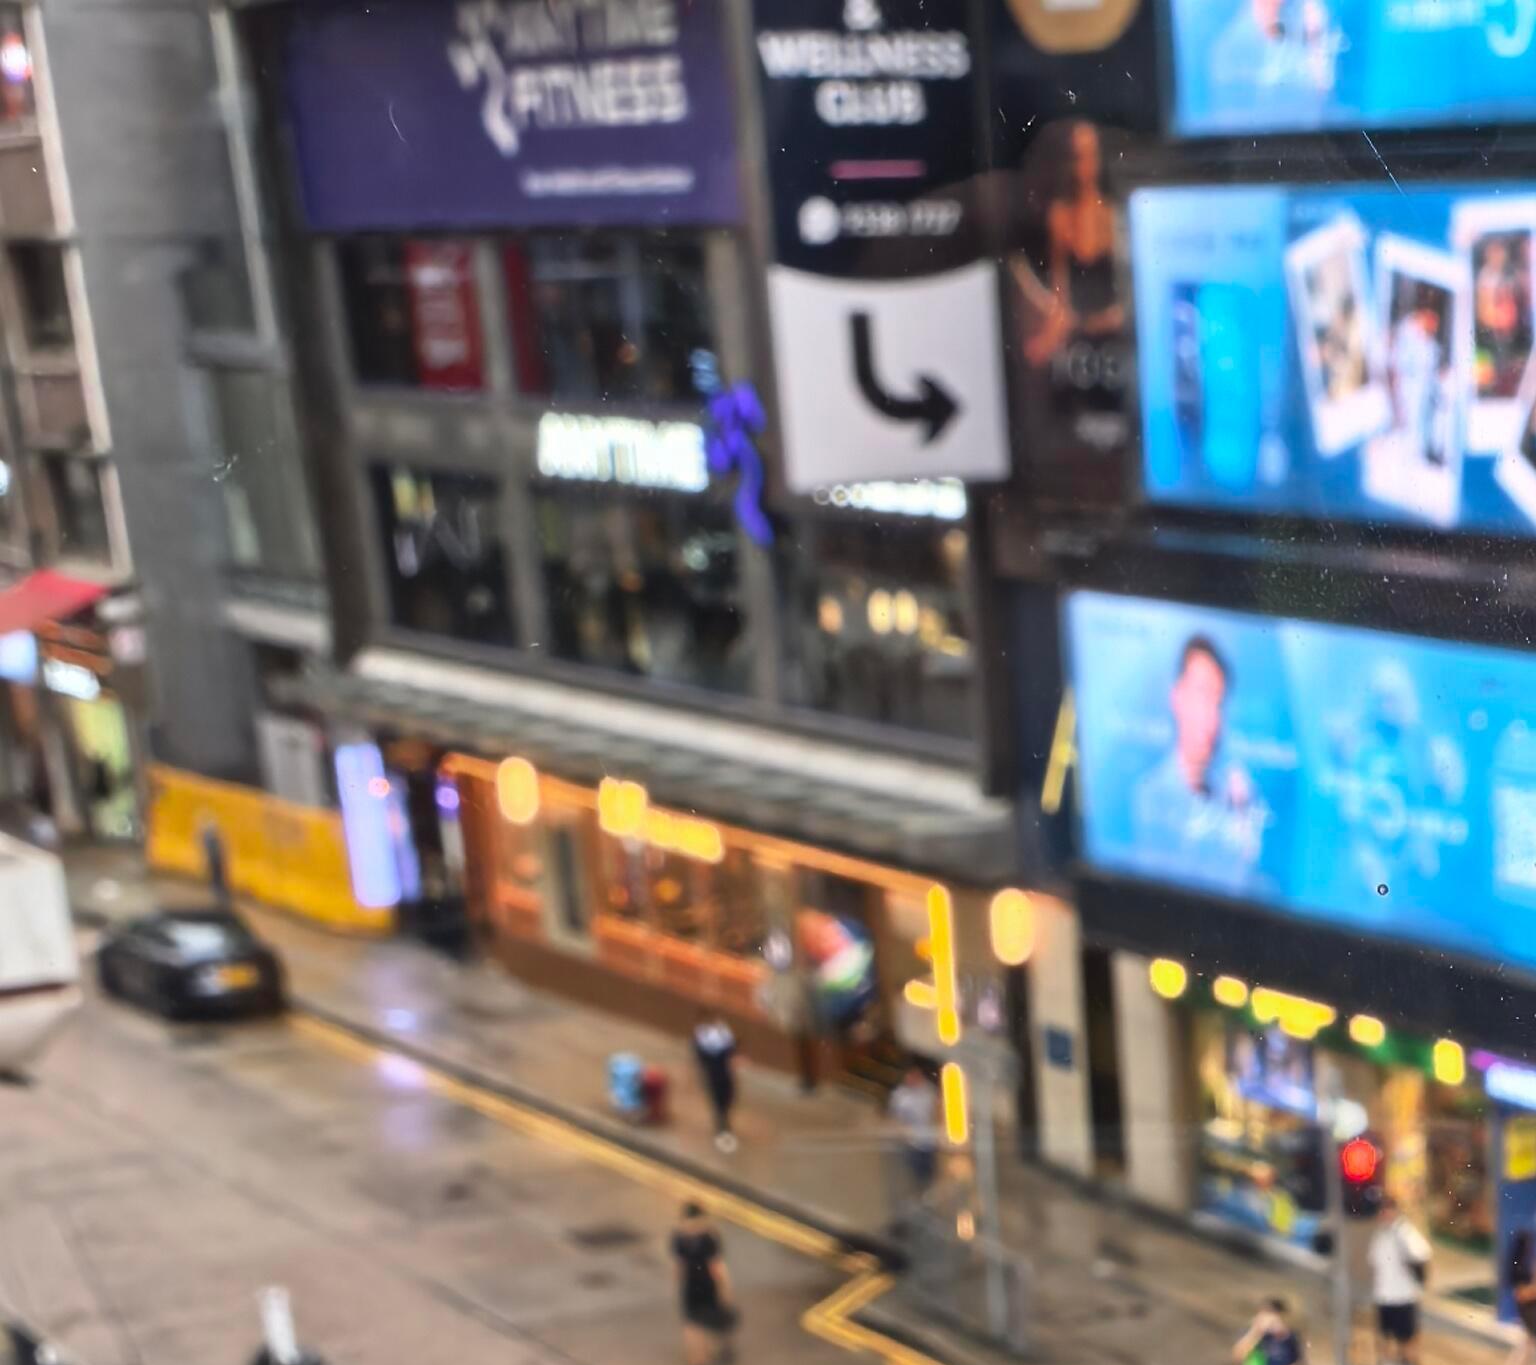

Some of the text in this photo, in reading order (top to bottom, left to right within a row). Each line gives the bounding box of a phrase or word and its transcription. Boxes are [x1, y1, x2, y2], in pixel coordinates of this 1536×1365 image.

[757, 30, 970, 79] WELLNESS
[510, 56, 688, 128] FITNESS
[815, 80, 926, 126] CLUB
